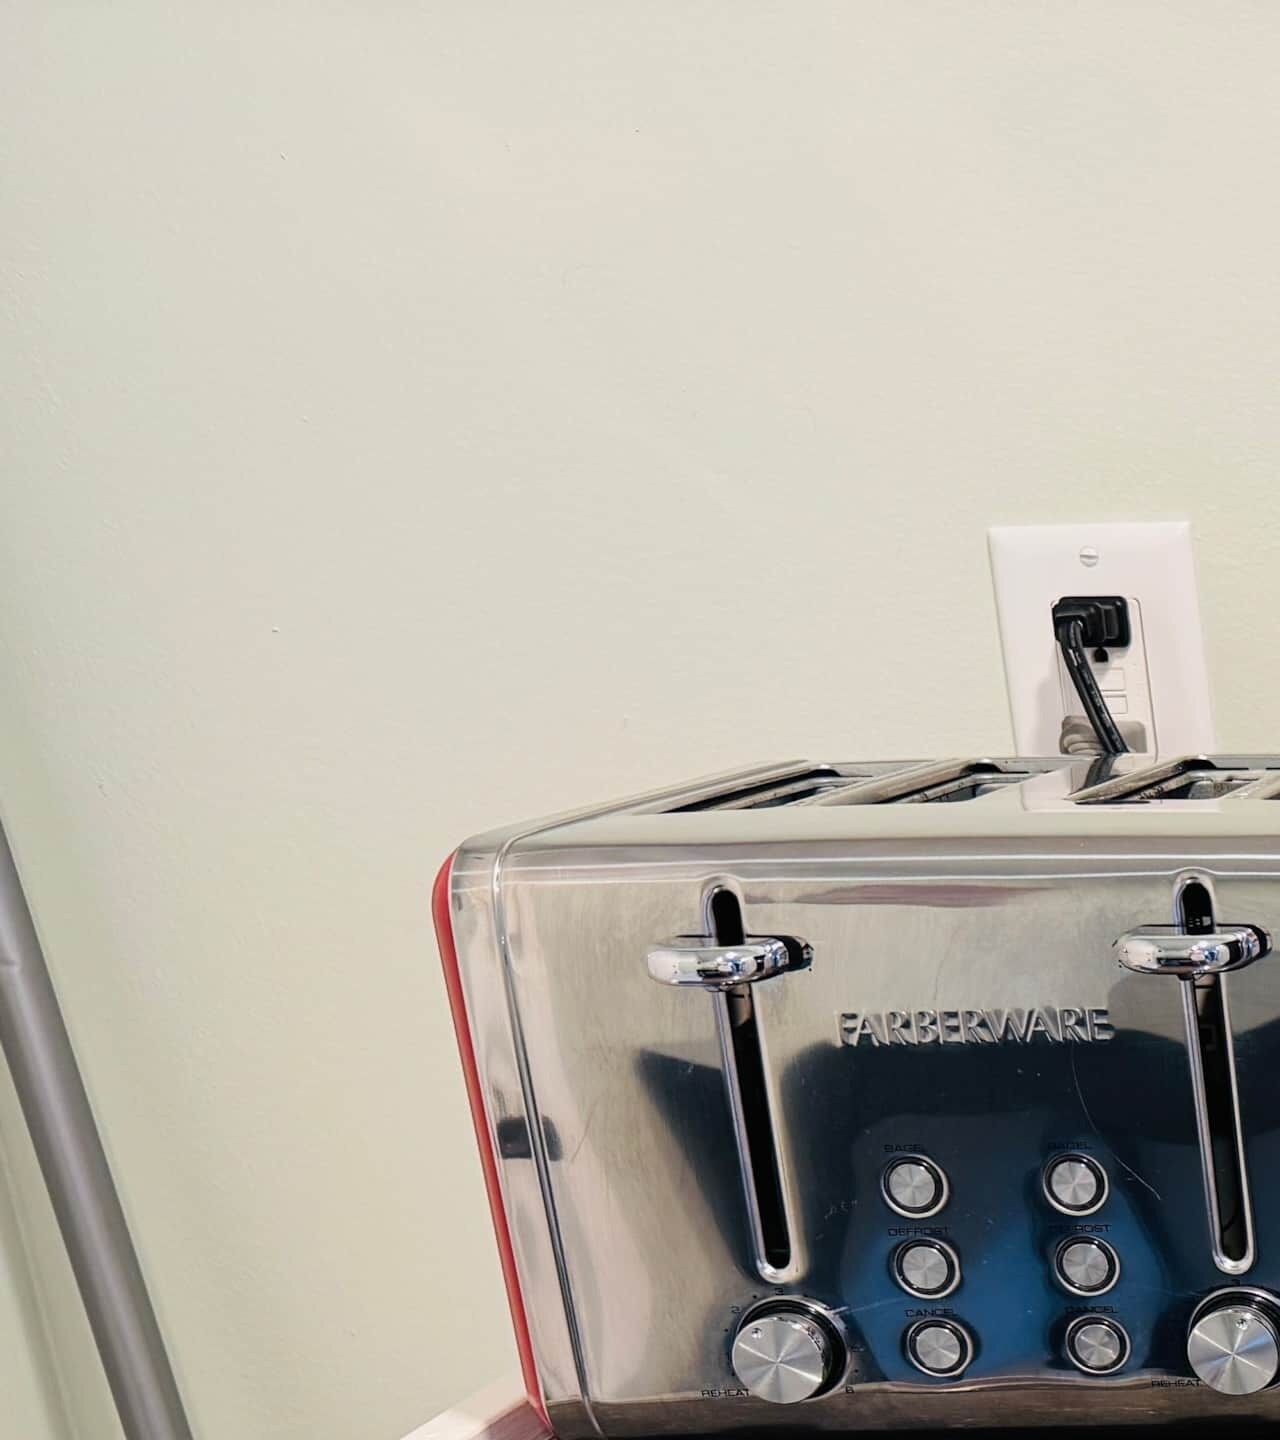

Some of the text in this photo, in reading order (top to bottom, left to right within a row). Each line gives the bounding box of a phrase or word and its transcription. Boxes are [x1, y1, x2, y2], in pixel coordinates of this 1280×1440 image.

[835, 1007, 1115, 1047] FARBERWARE
[888, 1226, 950, 1237] DEFROST
[904, 1308, 957, 1318] CANCEL
[701, 1389, 751, 1397] REHEAT
